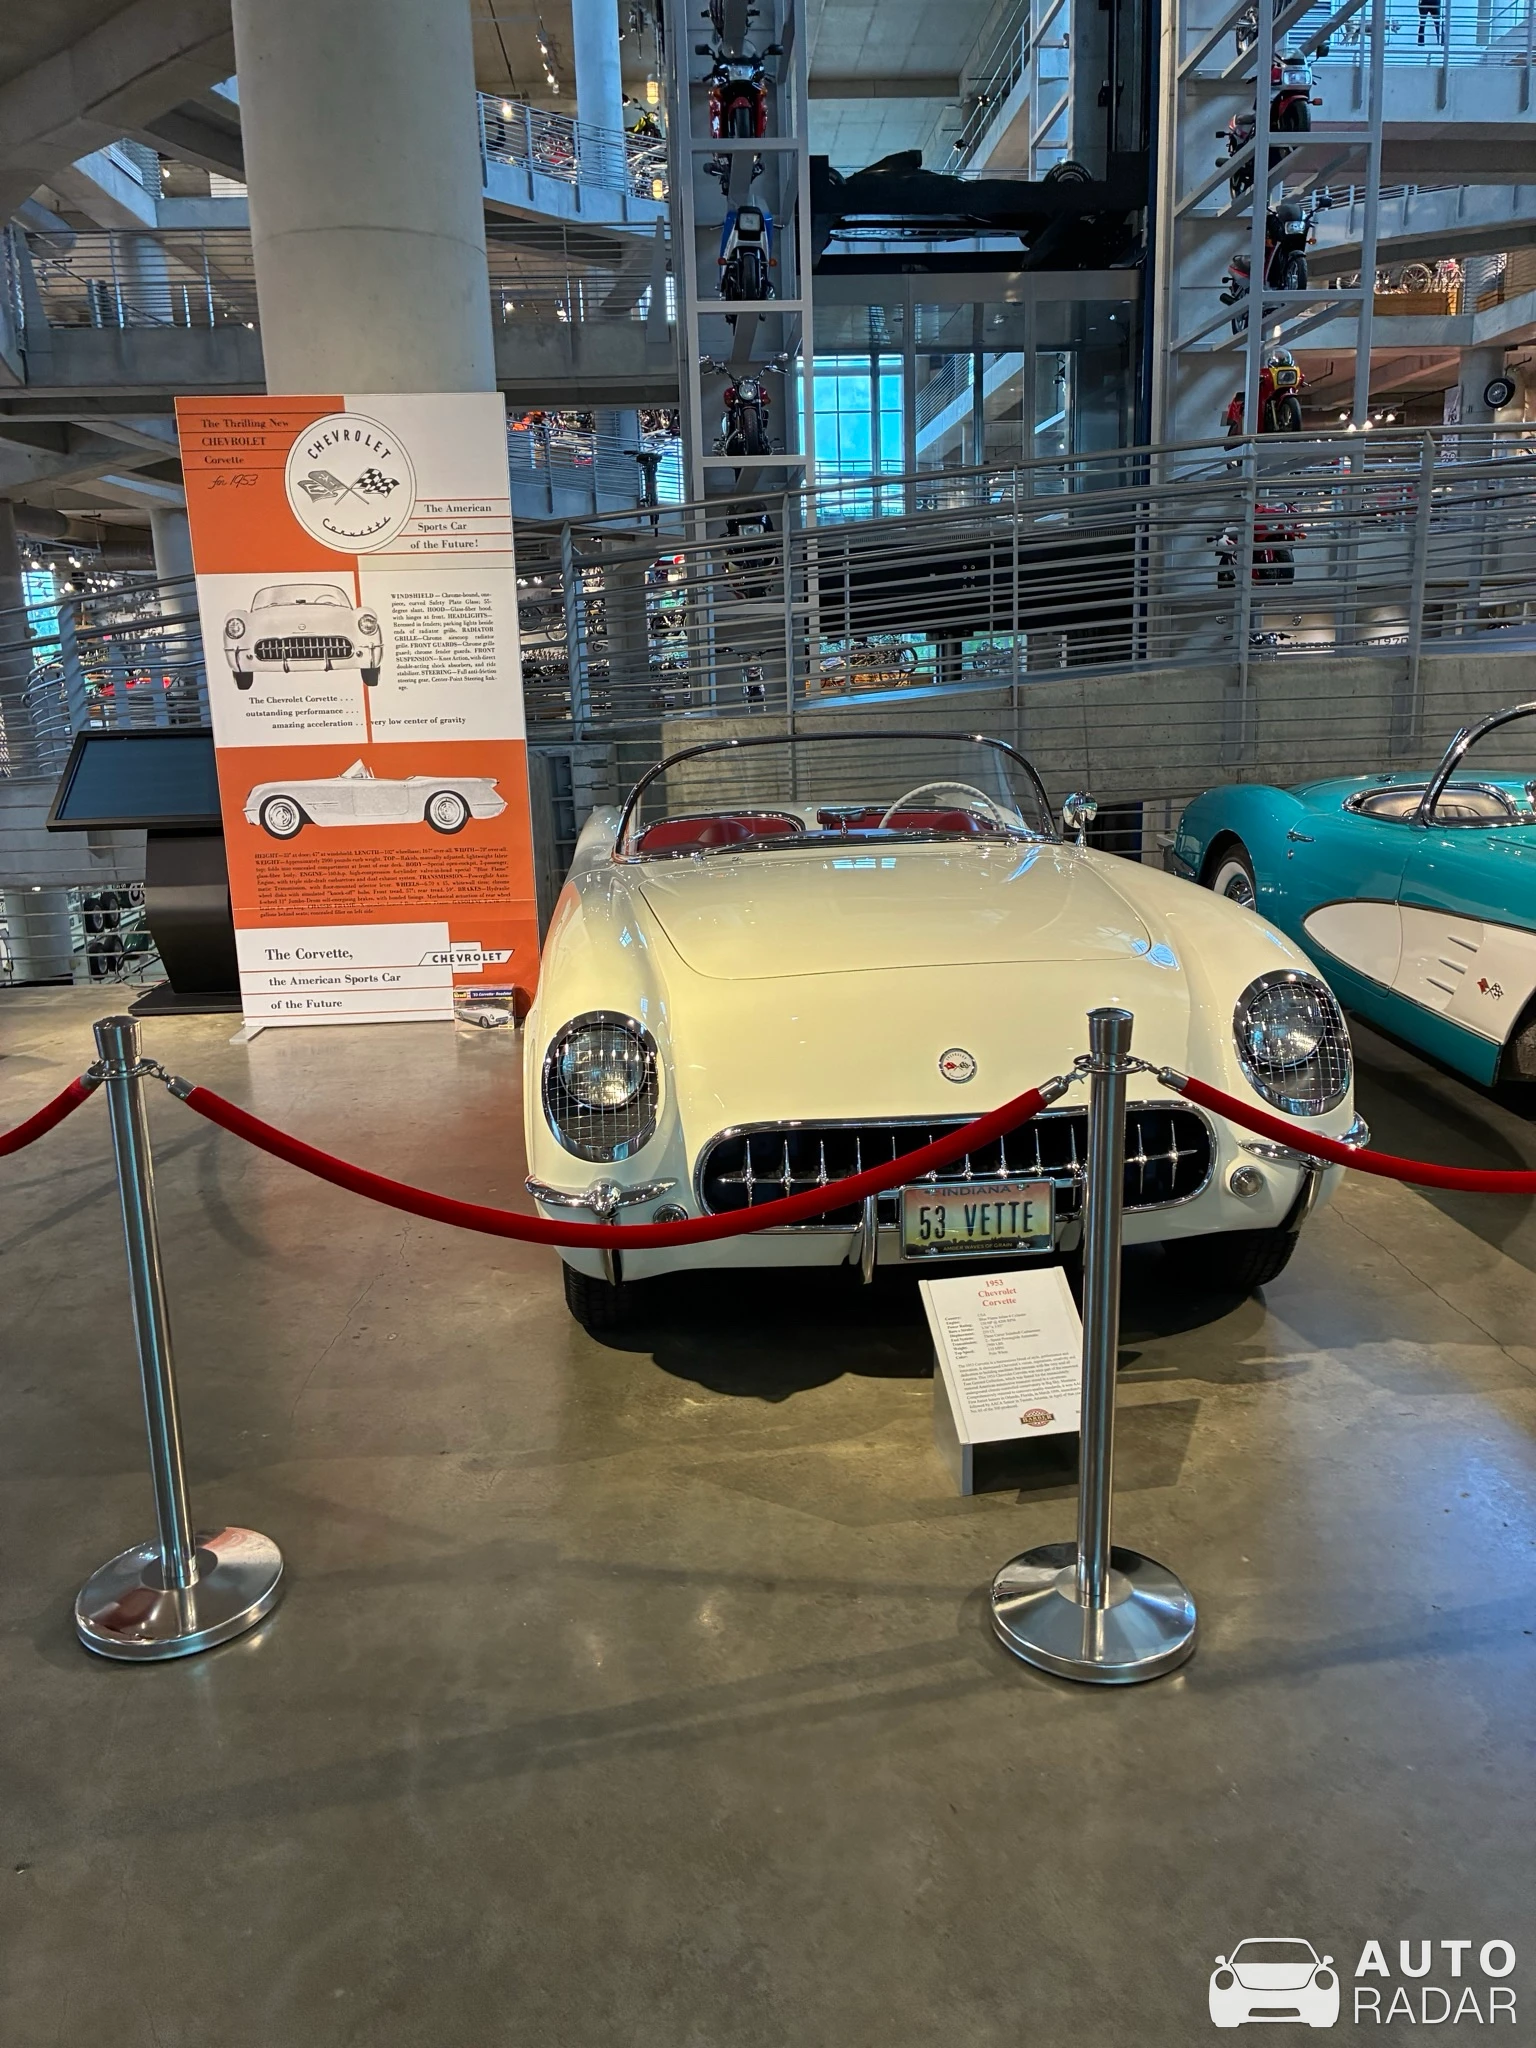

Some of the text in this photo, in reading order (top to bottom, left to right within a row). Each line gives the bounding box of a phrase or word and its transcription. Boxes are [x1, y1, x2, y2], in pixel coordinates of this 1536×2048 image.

[200, 418, 290, 429] The Thrilling New
[201, 436, 266, 446] CHEVROLET
[308, 429, 392, 460] CHEVROLET
[204, 455, 244, 465] Corvette
[208, 474, 258, 490] for 1953
[424, 503, 492, 513] The American
[322, 516, 392, 537] Corvette
[418, 521, 467, 532] Sports Car
[410, 539, 478, 548] of the Future!
[266, 696, 303, 704] Chevrolet
[305, 695, 338, 703] Corvette
[246, 708, 343, 718] outstanding performance
[272, 722, 305, 730] amazing
[307, 720, 353, 728] acceleration
[370, 719, 386, 727] very
[430, 717, 438, 725] of
[440, 716, 466, 726] gravity
[265, 948, 502, 963] The Corvette, CHEVROLET
[269, 973, 401, 987] the American Sports Car
[271, 998, 342, 1010] of the Future
[942, 1185, 1011, 1196] INDIANA
[920, 1201, 1033, 1240] 53 VETTE
[986, 1279, 1004, 1287] 1953
[978, 1288, 1016, 1298] Chevrolet
[982, 1298, 1016, 1307] Corvette
